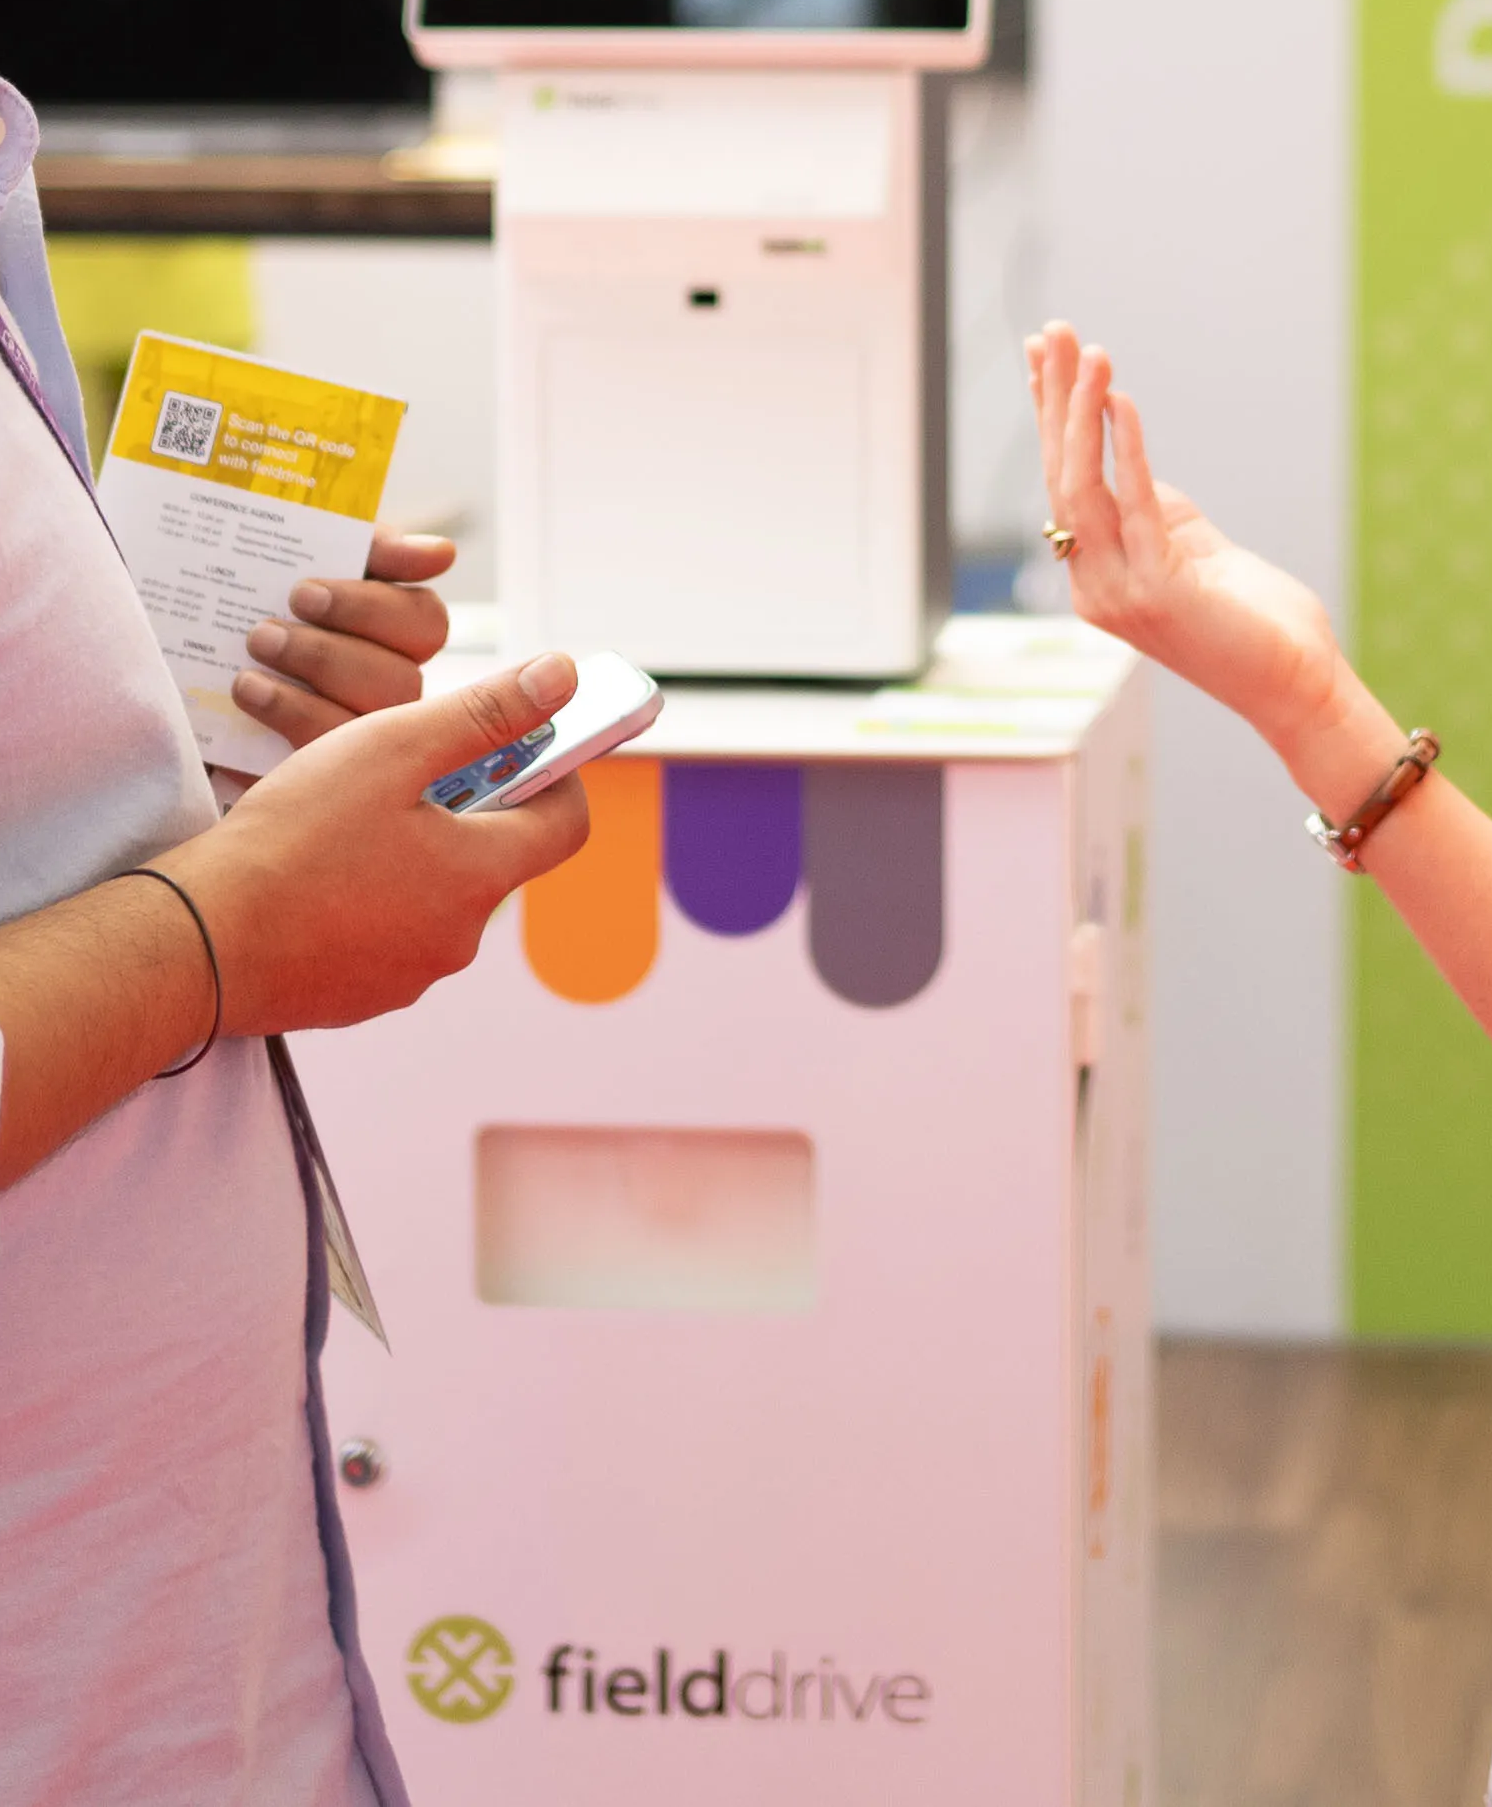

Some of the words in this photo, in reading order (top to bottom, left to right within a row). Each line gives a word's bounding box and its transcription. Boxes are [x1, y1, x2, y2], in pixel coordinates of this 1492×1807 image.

[223, 433, 236, 447] to
[241, 439, 299, 463] connect
[228, 413, 264, 434] Scan
[267, 424, 290, 441] the
[293, 429, 318, 449] QR
[319, 438, 356, 459] code
[218, 453, 248, 471] with
[542, 1644, 932, 1724] fielddrive
